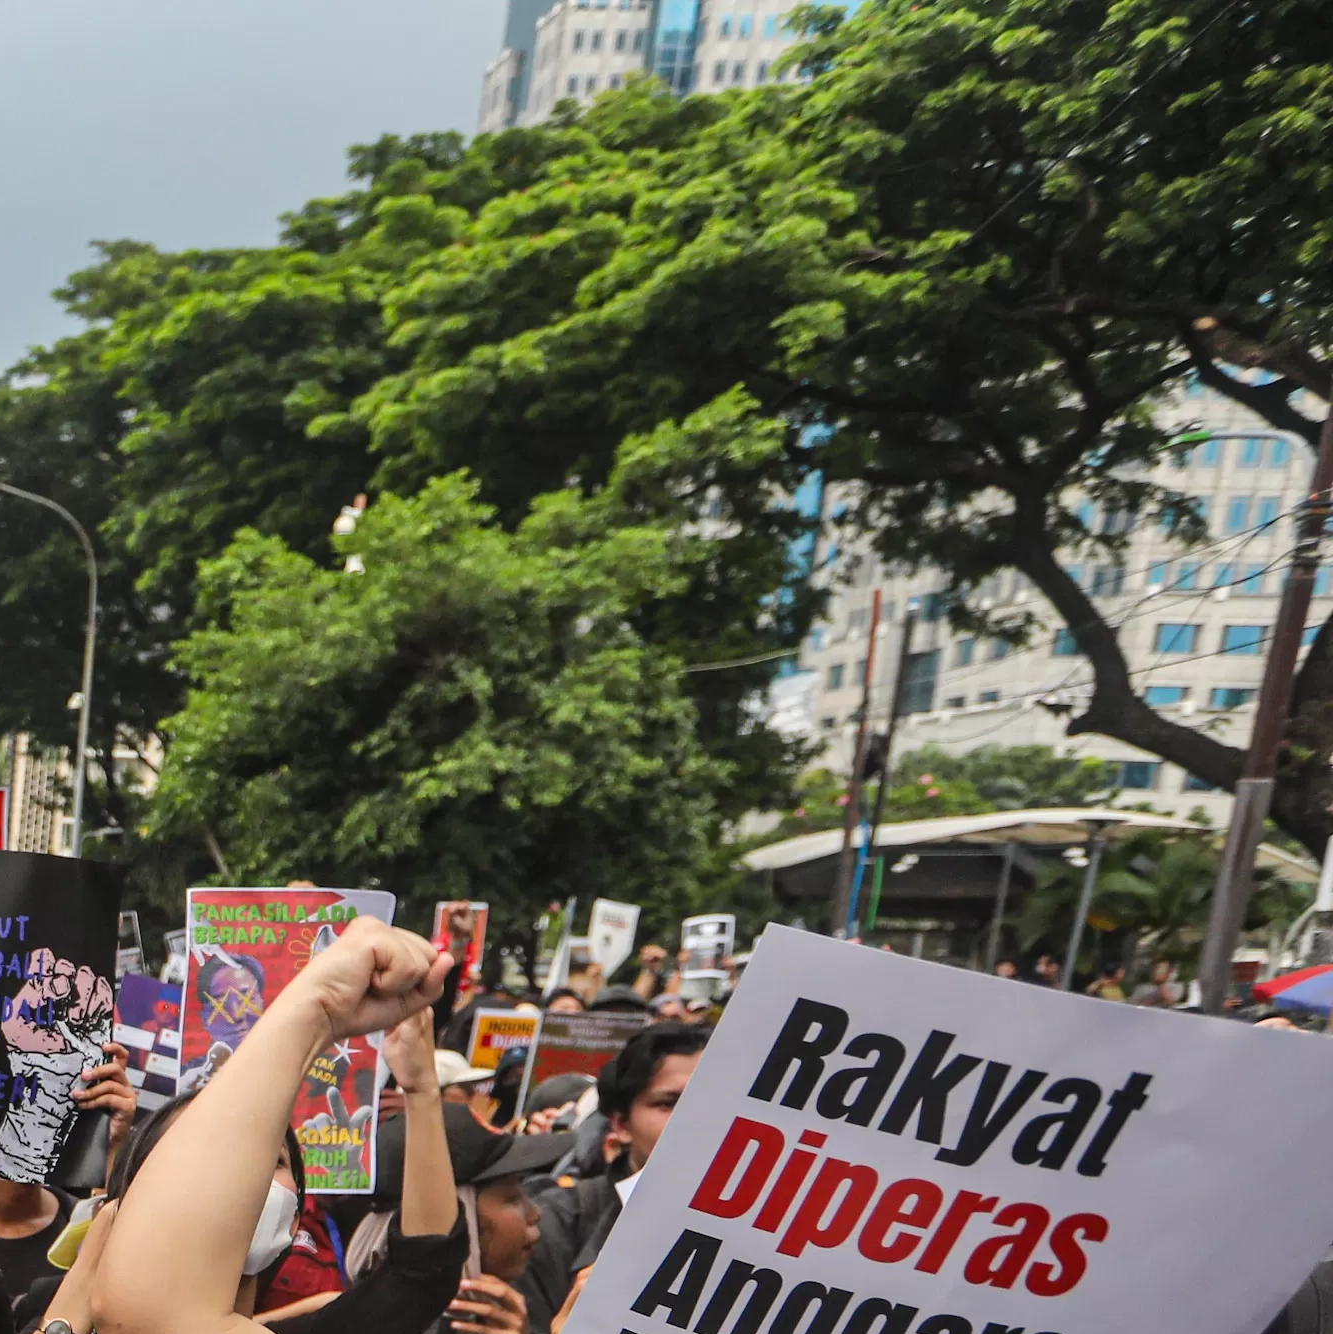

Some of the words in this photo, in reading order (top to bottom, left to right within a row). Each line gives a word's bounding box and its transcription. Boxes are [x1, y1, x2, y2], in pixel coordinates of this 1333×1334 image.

[193, 926, 288, 945] BERAPA?
[317, 905, 359, 922] ADA
[747, 997, 1154, 1178] Rakyat
[688, 1115, 1110, 1297] Diperas
